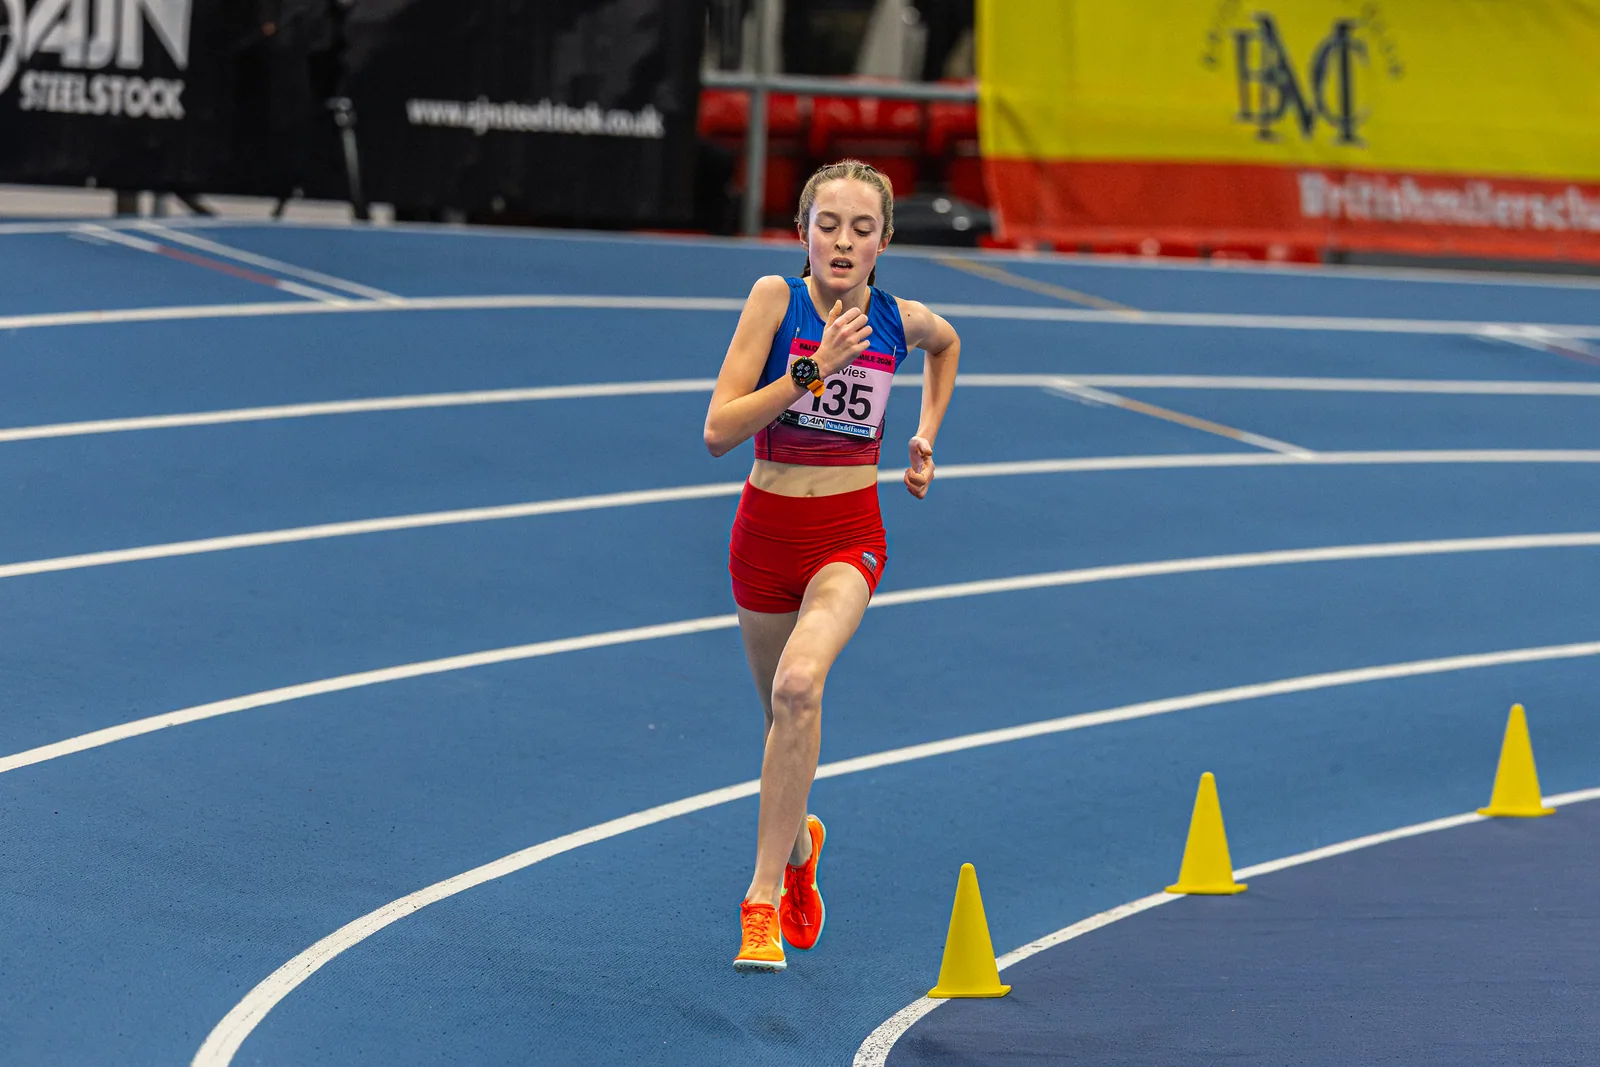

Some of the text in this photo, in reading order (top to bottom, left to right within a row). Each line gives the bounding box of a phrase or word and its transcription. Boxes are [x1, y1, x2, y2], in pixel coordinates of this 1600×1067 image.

[21, 0, 192, 70] AJN
[19, 70, 186, 119] STEELSTOCK
[858, 354, 875, 363] MILE
[876, 356, 892, 366] 2026
[837, 365, 867, 379] vies
[808, 416, 825, 425] AJN
